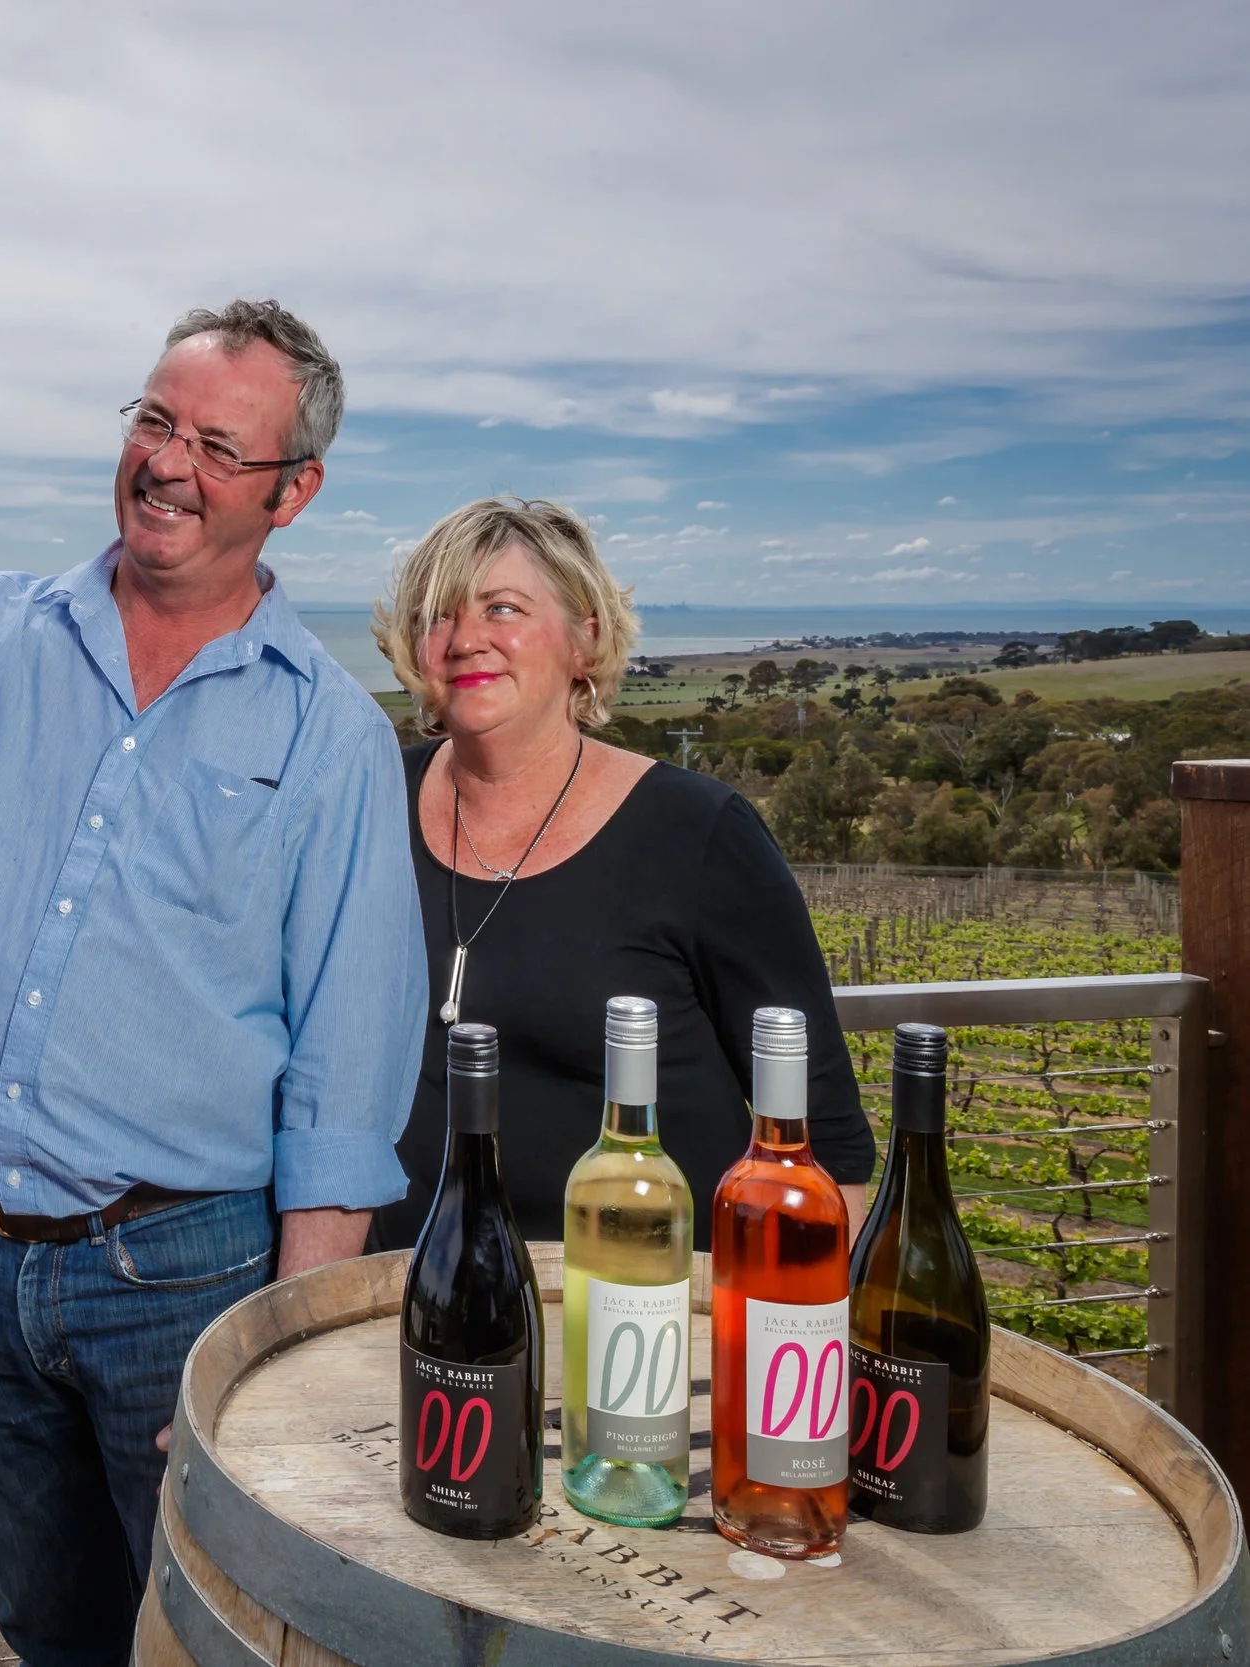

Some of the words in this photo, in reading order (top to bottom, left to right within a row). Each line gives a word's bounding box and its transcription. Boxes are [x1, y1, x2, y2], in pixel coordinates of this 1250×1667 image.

[604, 1296, 635, 1308] JACK
[643, 1296, 681, 1309] RABBIT
[764, 1316, 798, 1328] JACK
[806, 1315, 843, 1328] RABBIT
[849, 1348, 868, 1364] ACK
[874, 1359, 922, 1378] RABBIT
[415, 1359, 441, 1375] JACK
[447, 1369, 494, 1382] RABBIT
[435, 1377, 494, 1390] BELLARINE
[606, 1430, 640, 1443] PINOT
[644, 1431, 678, 1443] GRIGIO
[791, 1456, 826, 1469] ROSÉ
[857, 1469, 896, 1490] SHIRAZ
[431, 1484, 471, 1500] SHIRAZ
[425, 1492, 458, 1508] BELLARINE
